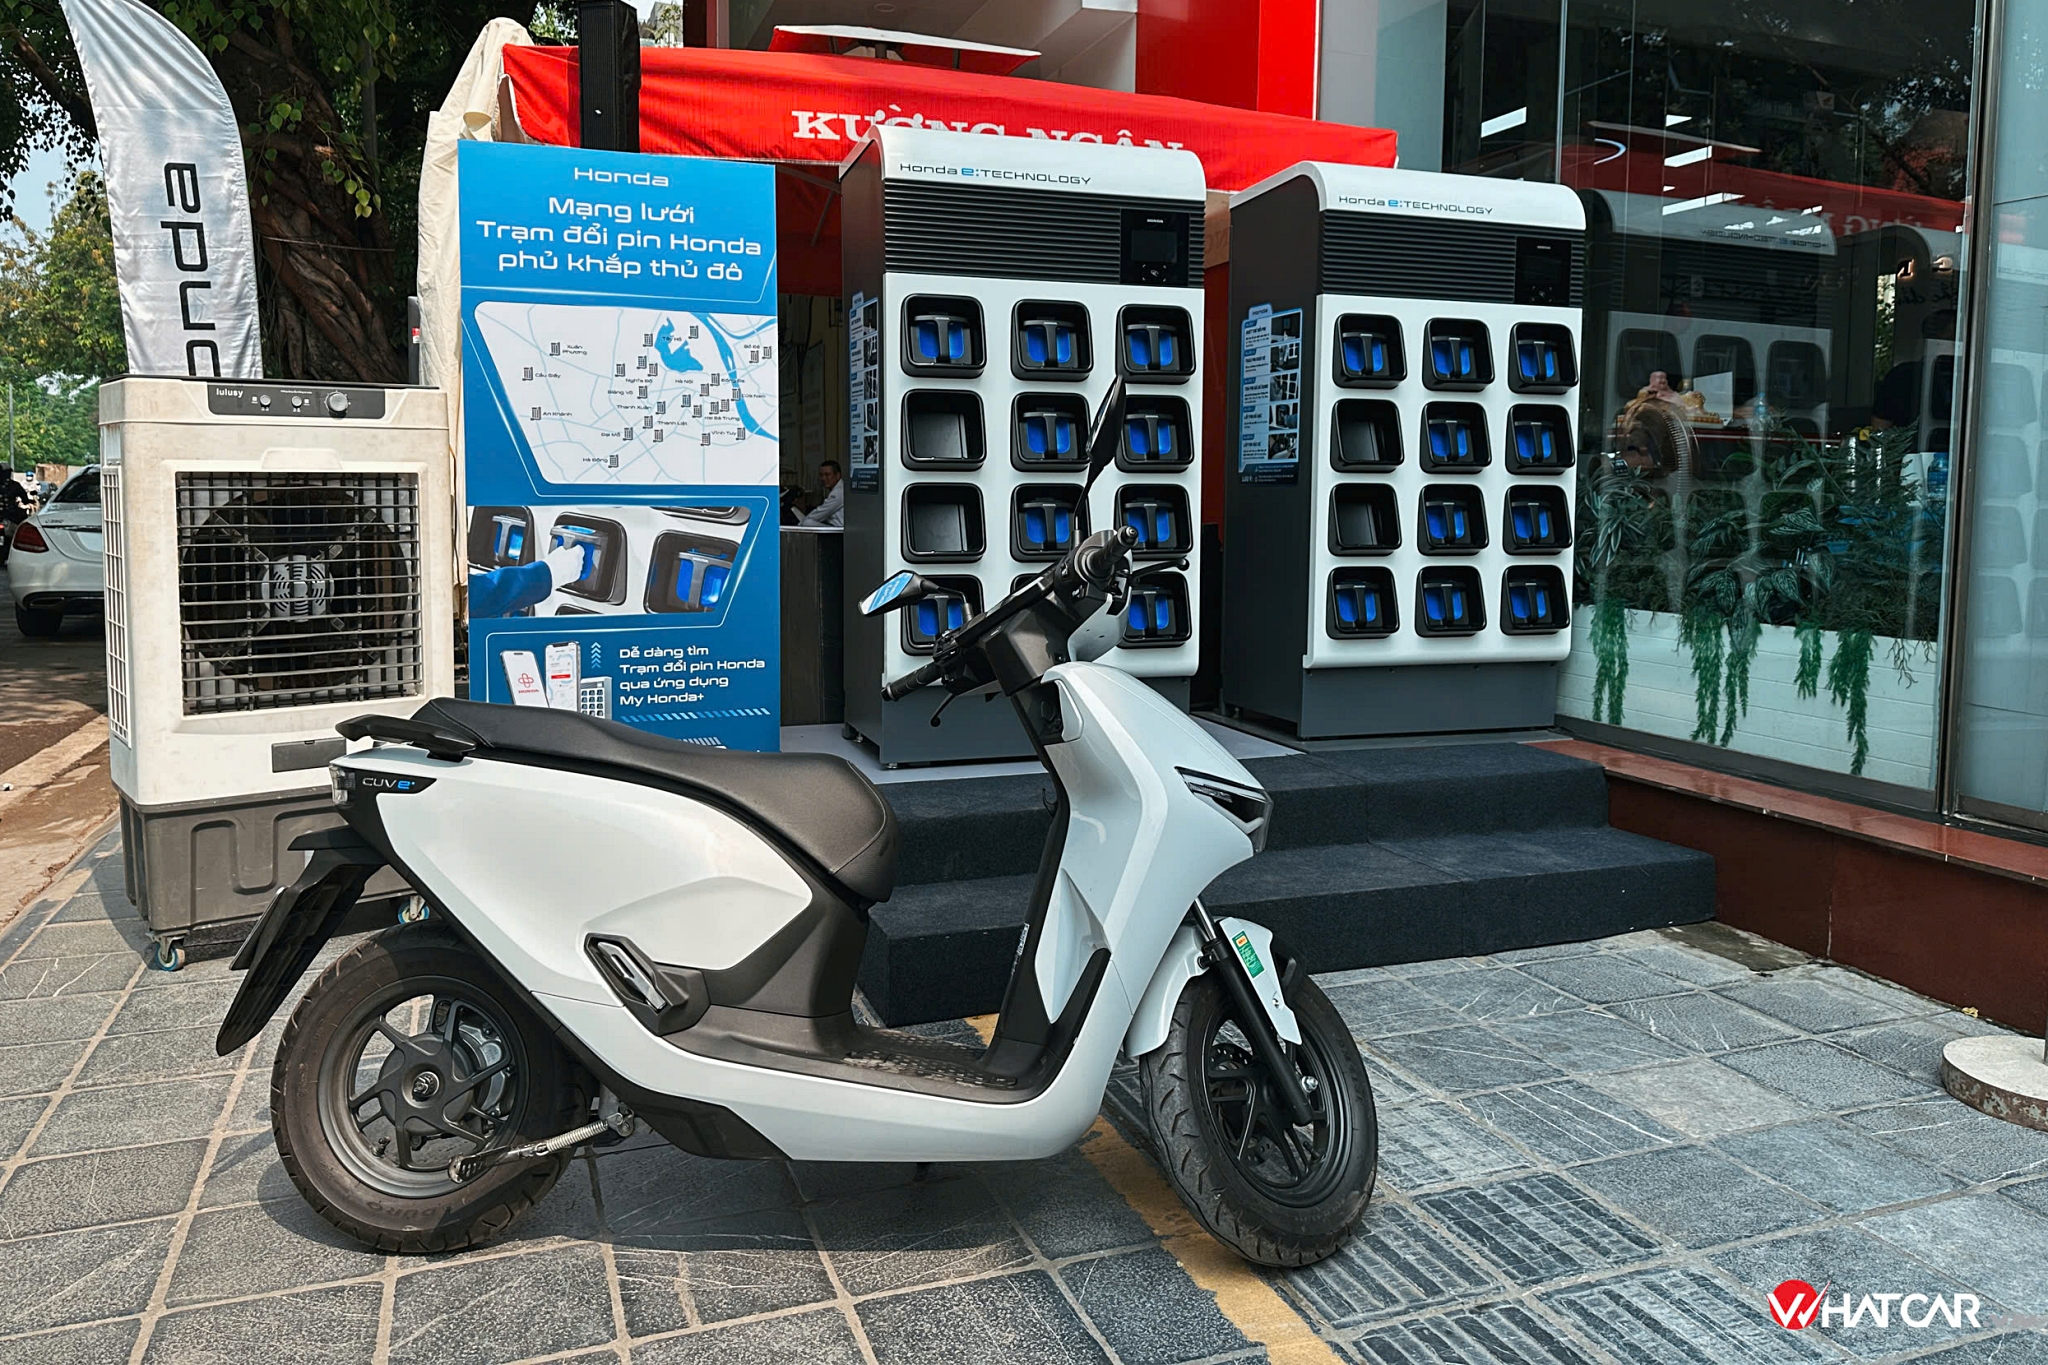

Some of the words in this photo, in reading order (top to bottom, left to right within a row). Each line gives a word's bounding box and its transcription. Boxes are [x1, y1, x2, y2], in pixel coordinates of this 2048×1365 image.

[574, 167, 669, 187] Honda
[900, 163, 957, 175] Honda
[961, 166, 1091, 186] e:TECHNOLOGY
[549, 196, 632, 223] Mạng
[641, 202, 695, 224] lưới
[1338, 195, 1386, 207] Honda
[476, 220, 554, 244] Trạm
[563, 223, 608, 246] đổi
[617, 229, 661, 250] pin
[670, 233, 761, 256] Honda
[160, 162, 221, 377] onda
[498, 251, 558, 272] phủ
[568, 252, 641, 278] khắp
[649, 258, 699, 280] thủ
[706, 262, 743, 281] đô
[216, 387, 243, 398] lulusy
[619, 645, 640, 659] Dễ
[643, 646, 683, 660] dàng
[687, 645, 709, 656] tìm
[619, 662, 660, 677] Trạm
[663, 660, 687, 673] đổi
[690, 661, 715, 675] pin
[717, 659, 766, 671] Honda
[619, 680, 650, 693] qua
[653, 677, 685, 691] ứng
[689, 676, 729, 690] dụng
[619, 695, 644, 709] My
[647, 693, 705, 705] Honda+
